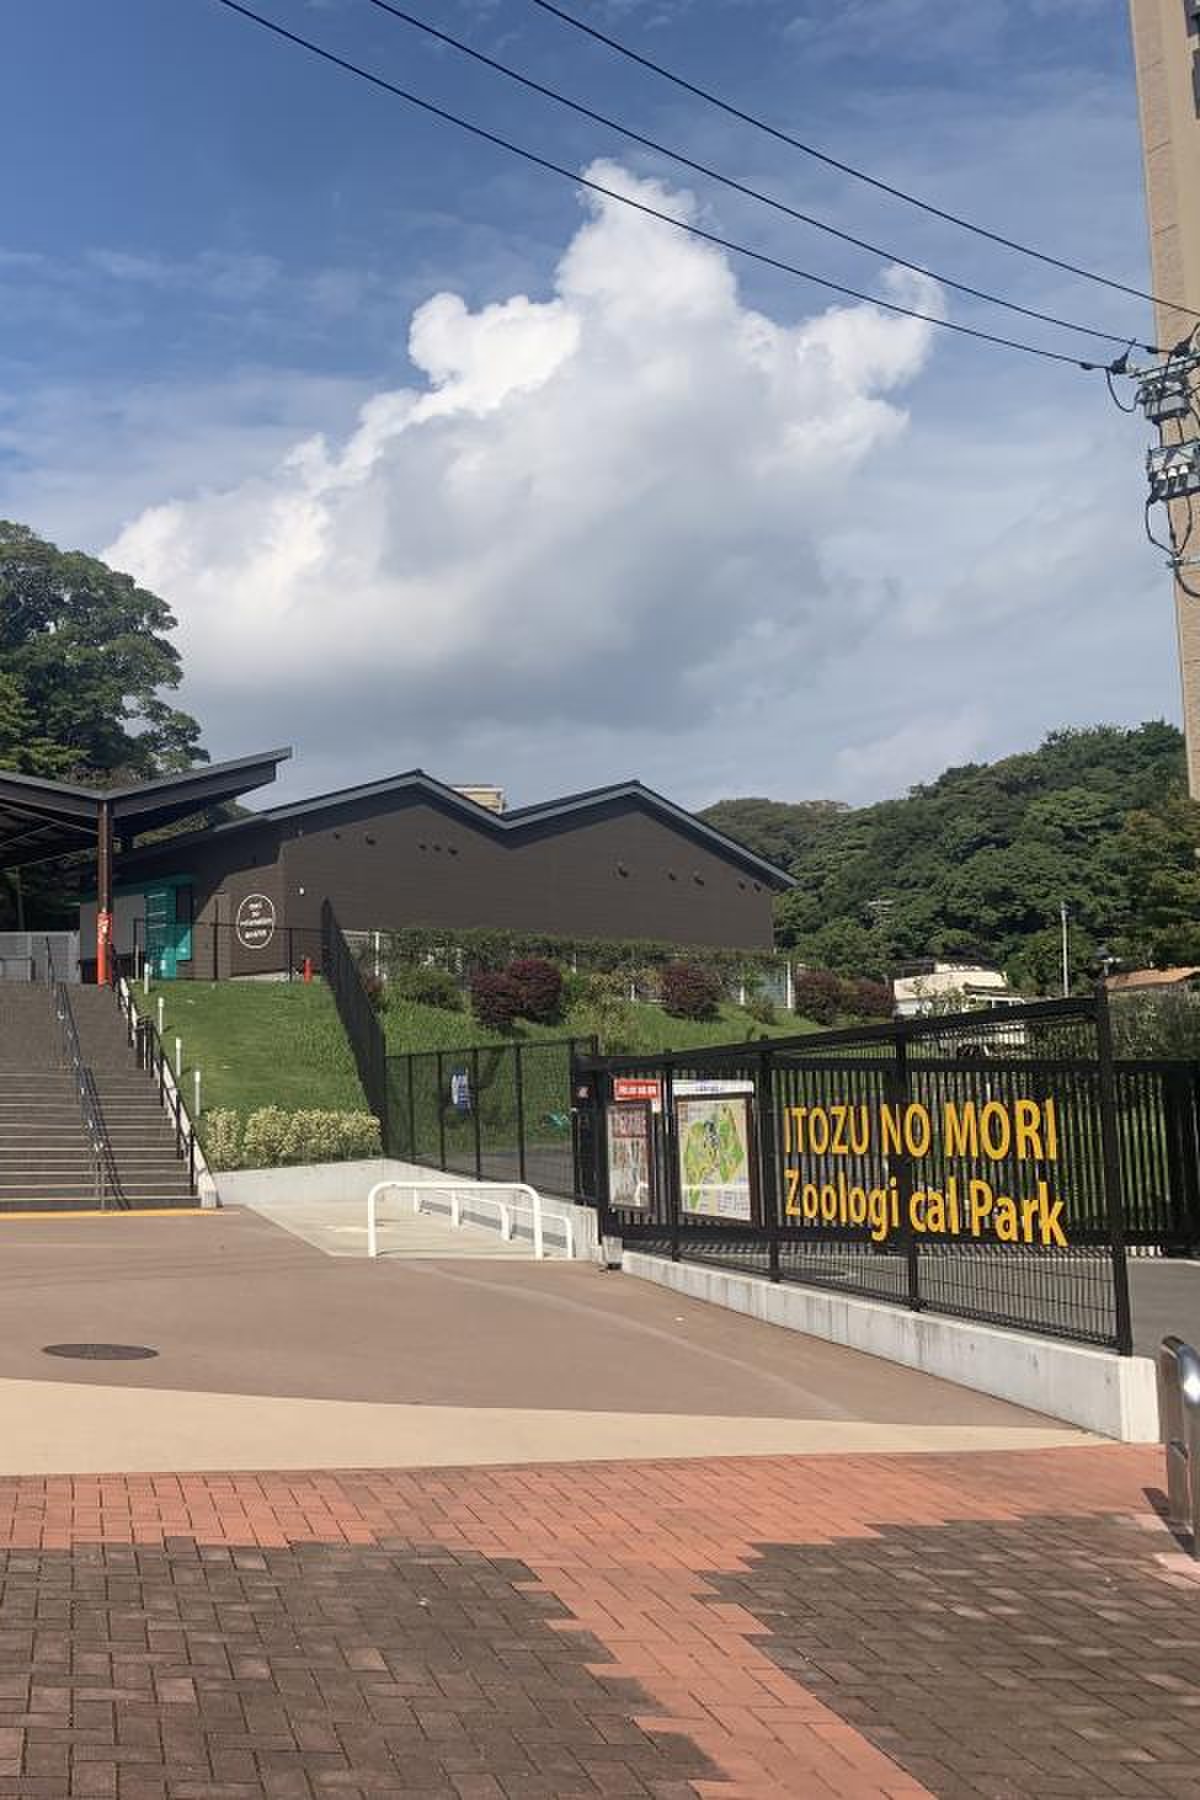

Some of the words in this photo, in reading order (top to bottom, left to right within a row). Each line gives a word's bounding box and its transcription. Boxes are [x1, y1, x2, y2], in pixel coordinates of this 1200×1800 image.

[784, 1105, 869, 1154] ITOZU
[881, 1103, 930, 1157] NO
[945, 1097, 1057, 1160] MORI
[970, 1179, 1068, 1247] Park
